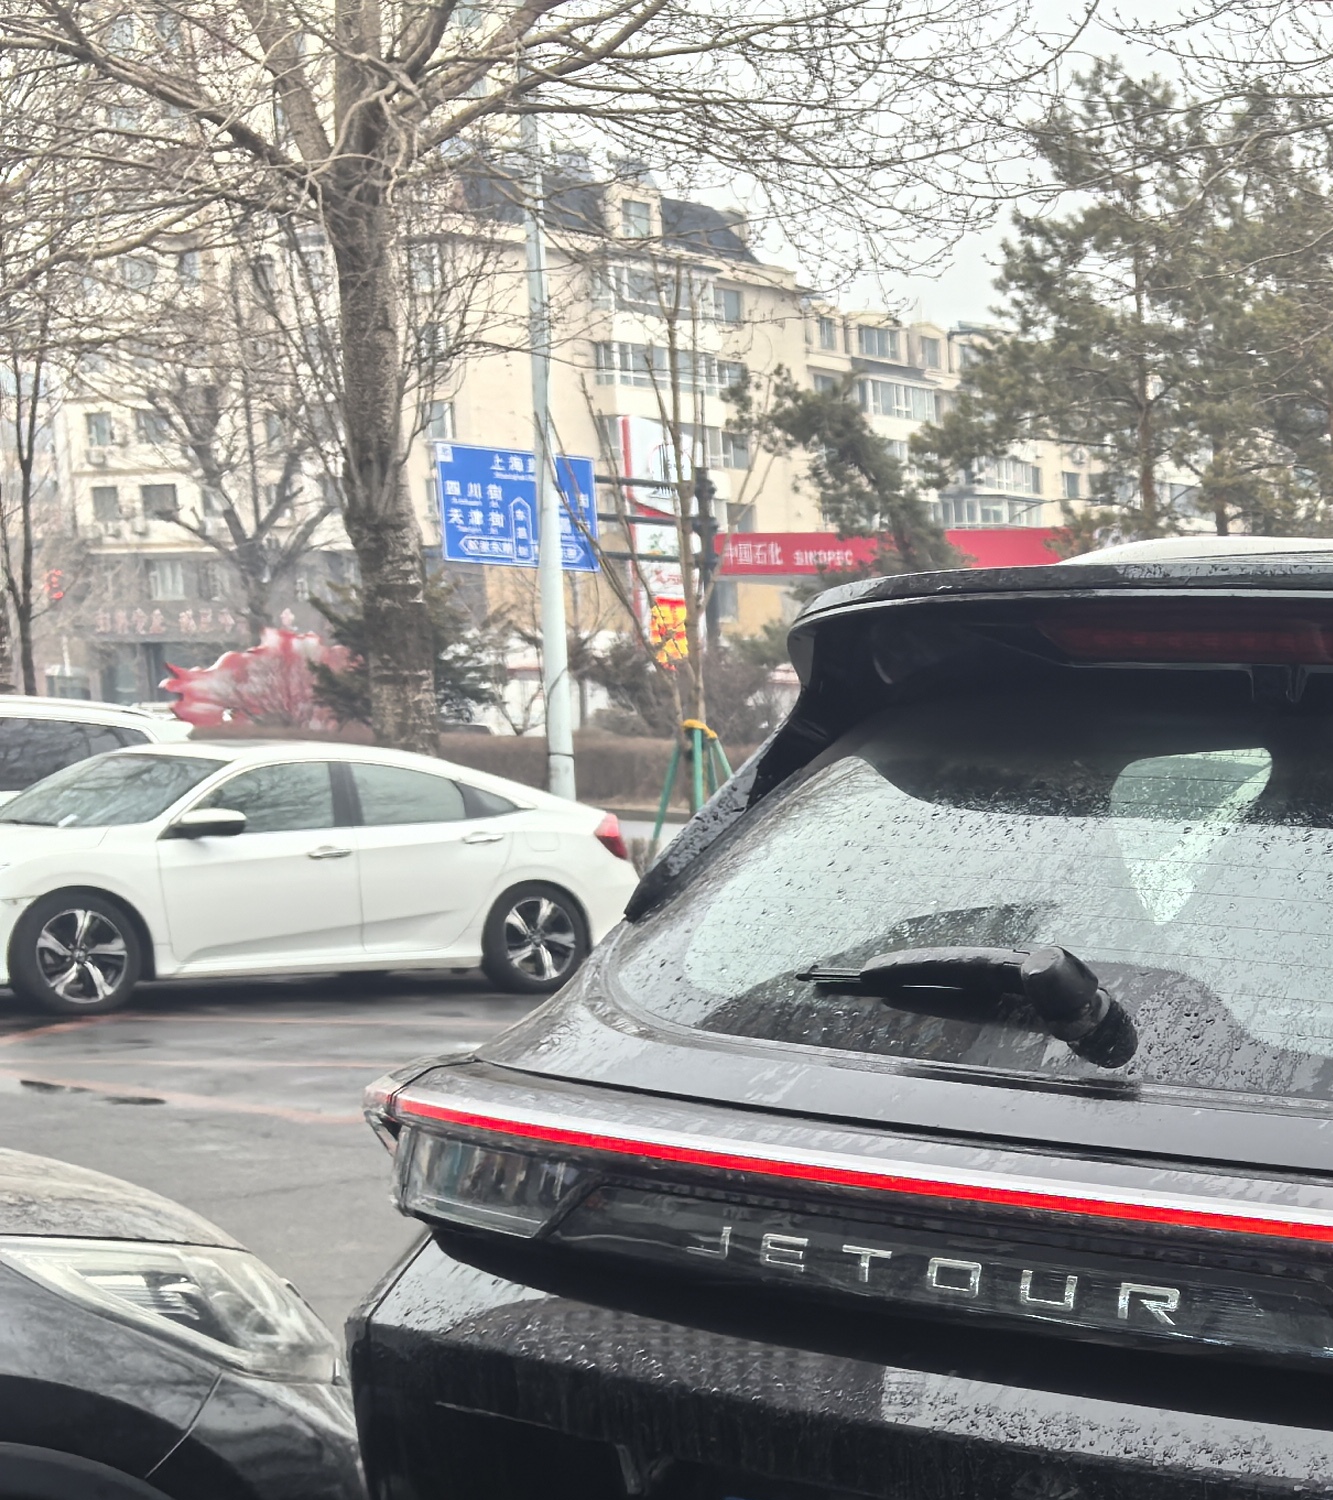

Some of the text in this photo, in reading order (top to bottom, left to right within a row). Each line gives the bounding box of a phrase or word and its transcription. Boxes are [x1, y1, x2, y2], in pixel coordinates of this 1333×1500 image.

[725, 541, 853, 566] 中国石化 SINOPEC
[687, 1225, 1181, 1326] JETOUR
